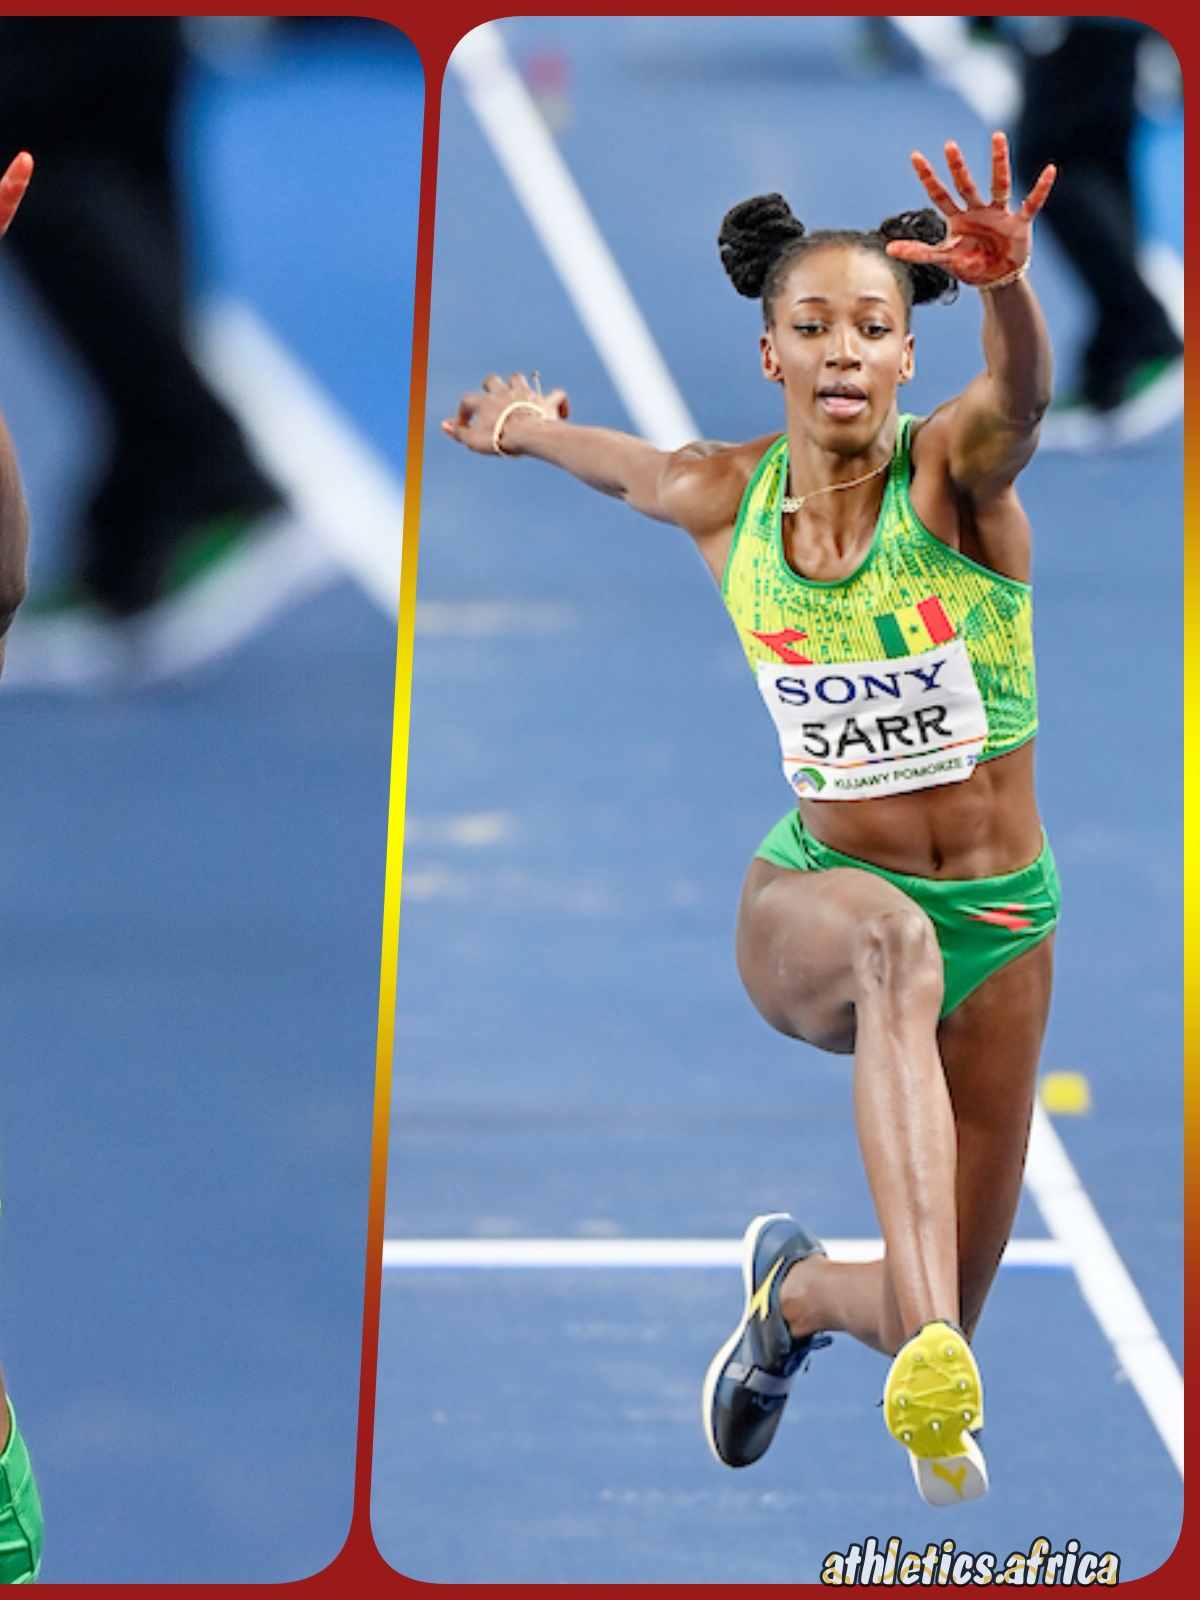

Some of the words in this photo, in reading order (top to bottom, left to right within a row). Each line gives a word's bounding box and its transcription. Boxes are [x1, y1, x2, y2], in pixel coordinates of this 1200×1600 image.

[775, 659, 946, 705] SONY
[834, 773, 889, 789] KUJAWY
[894, 757, 963, 781] POMORZE
